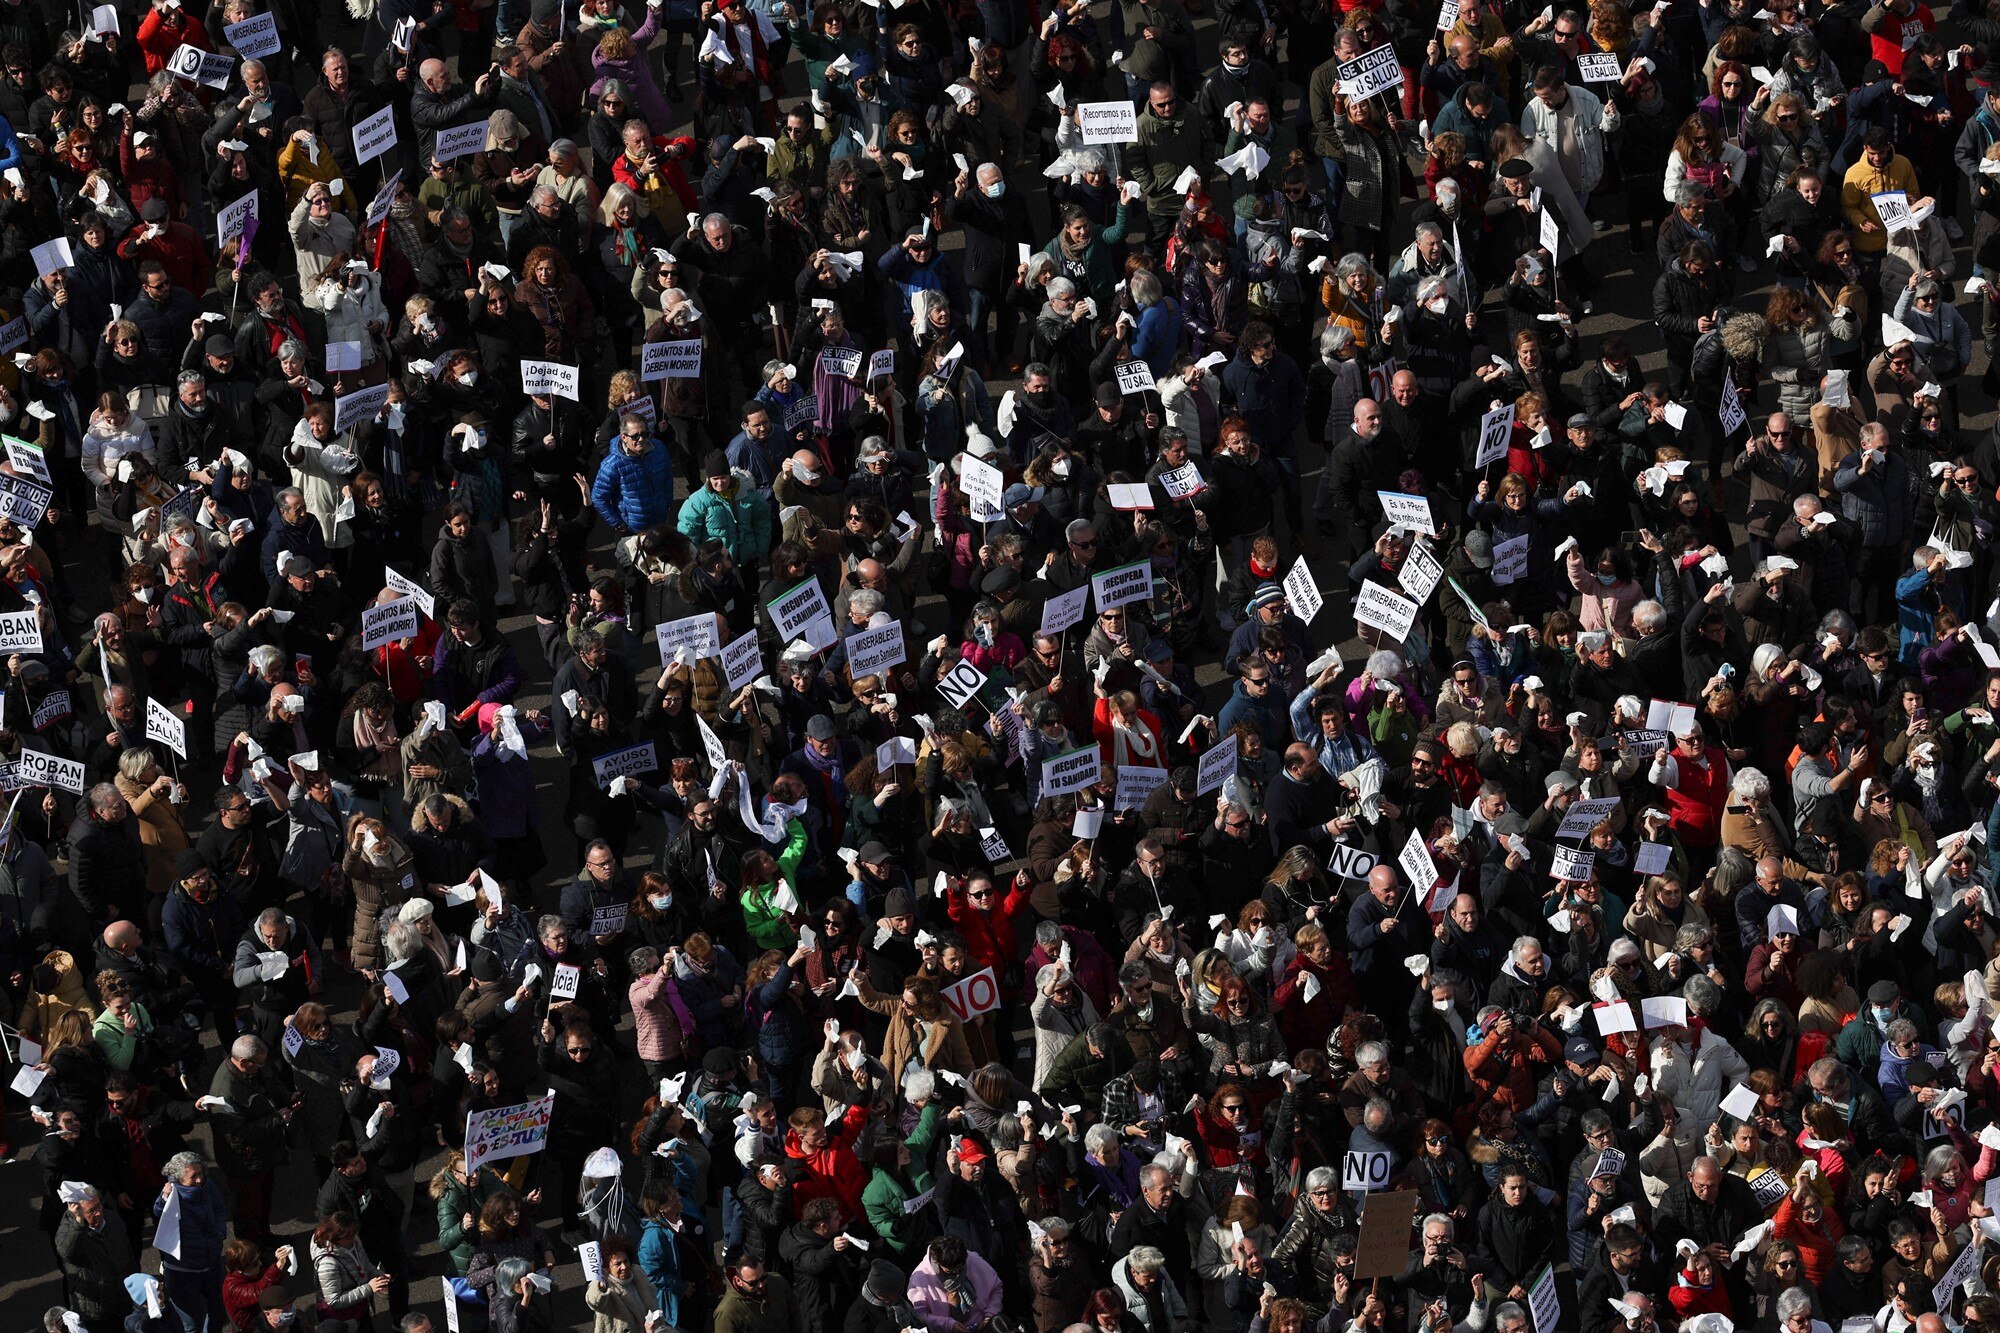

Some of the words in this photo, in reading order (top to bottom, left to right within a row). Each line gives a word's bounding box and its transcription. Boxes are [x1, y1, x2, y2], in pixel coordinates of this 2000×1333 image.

[1341, 64, 1358, 82] SE
[1356, 49, 1395, 73] VENDE
[1580, 57, 1591, 67] SE
[1592, 54, 1617, 66] VENDE
[1584, 68, 1596, 79] TU
[1083, 108, 1119, 122] ¡Recortemos
[441, 130, 469, 146] ¡Dejad
[470, 127, 482, 138] de
[1085, 127, 1094, 136] los
[439, 138, 482, 156] matarnos!
[644, 344, 684, 361] ¿CUÁNTOS
[684, 341, 701, 356] MÁS
[823, 346, 834, 357] SE
[835, 348, 861, 362] VENDE
[526, 365, 559, 377] ¡Dejad
[559, 370, 572, 381] de
[644, 360, 670, 374] DEBEN
[669, 359, 699, 371] MORIR?
[823, 359, 833, 371] TU
[1116, 366, 1128, 377] SE
[525, 378, 574, 393] matarnos!
[1121, 378, 1133, 391] TU
[784, 407, 794, 419] SE
[793, 396, 818, 414] VENDE
[785, 416, 795, 429] TU
[1486, 407, 1512, 430] ASÍ
[1482, 425, 1507, 455] NO
[964, 481, 973, 489] no
[1163, 473, 1174, 483] SE
[12, 479, 48, 506] VENDE
[1170, 482, 1179, 495] TU
[1403, 561, 1413, 580] TU
[1410, 546, 1421, 561] SE
[1417, 552, 1440, 581] VENDE
[1103, 569, 1145, 592] ¡RECUPERA
[1293, 563, 1312, 598] ¿CUÁNTOS
[1308, 594, 1320, 612] MÁS
[779, 586, 816, 619] ¡RECUPERA
[1101, 593, 1112, 606] TU
[1111, 582, 1149, 602] SANIDAD!
[1287, 573, 1299, 598] DEBEN
[1296, 595, 1312, 620] MORIR?
[1361, 587, 1415, 620] ¡¡¡MISERABLES!!!
[364, 603, 398, 631] ¿CUÁNTOS
[397, 600, 415, 619] MÁS
[782, 619, 794, 633] TU
[791, 598, 824, 628] SANIDAD!
[1048, 611, 1061, 622] ¡Con
[1355, 602, 1385, 622] ¡Recortan
[0, 616, 38, 636] BAN
[365, 623, 388, 643] DEBEN
[387, 617, 415, 636] MORIR?
[1047, 622, 1056, 630] no
[1056, 619, 1064, 628] se
[1, 636, 40, 647] SALUD!
[660, 631, 672, 640] Para
[746, 634, 759, 653] MÁS
[849, 625, 901, 657] ¡¡¡MISERABLES!!!
[852, 651, 881, 675] ¡Recortan
[879, 643, 903, 661] Sanidad!
[728, 663, 747, 682] DEBEN
[937, 663, 981, 707] NO
[34, 712, 46, 727] TU
[148, 704, 170, 724] ¡Por
[172, 720, 182, 737] la
[147, 718, 184, 749] SALUD
[1627, 732, 1638, 742] SE
[1639, 729, 1666, 741] VENDE
[24, 752, 82, 781] ROBAN
[1052, 753, 1094, 776] ¡RECUPERA
[1, 776, 13, 790] TU
[24, 766, 37, 779] TU
[40, 772, 81, 789] SALUD!
[1050, 776, 1062, 790] TU
[1061, 766, 1098, 787] SANIDAD!
[982, 840, 992, 850] SE
[988, 845, 1001, 859] TU
[1556, 845, 1568, 860] SE
[1567, 849, 1593, 865] VENDE
[1329, 844, 1375, 879] NO
[1403, 847, 1420, 875] DEBEN
[1554, 860, 1564, 875] TU
[1563, 862, 1589, 881] SALUD.
[595, 909, 605, 920] SE
[605, 906, 627, 918] VENDE
[594, 919, 605, 933] TU
[470, 1142, 488, 1165] NO
[1601, 1149, 1624, 1161] ENDE
[1346, 1151, 1389, 1183] NO
[1749, 1170, 1778, 1190] VENDE
[1757, 1182, 1787, 1205] SALUD.
